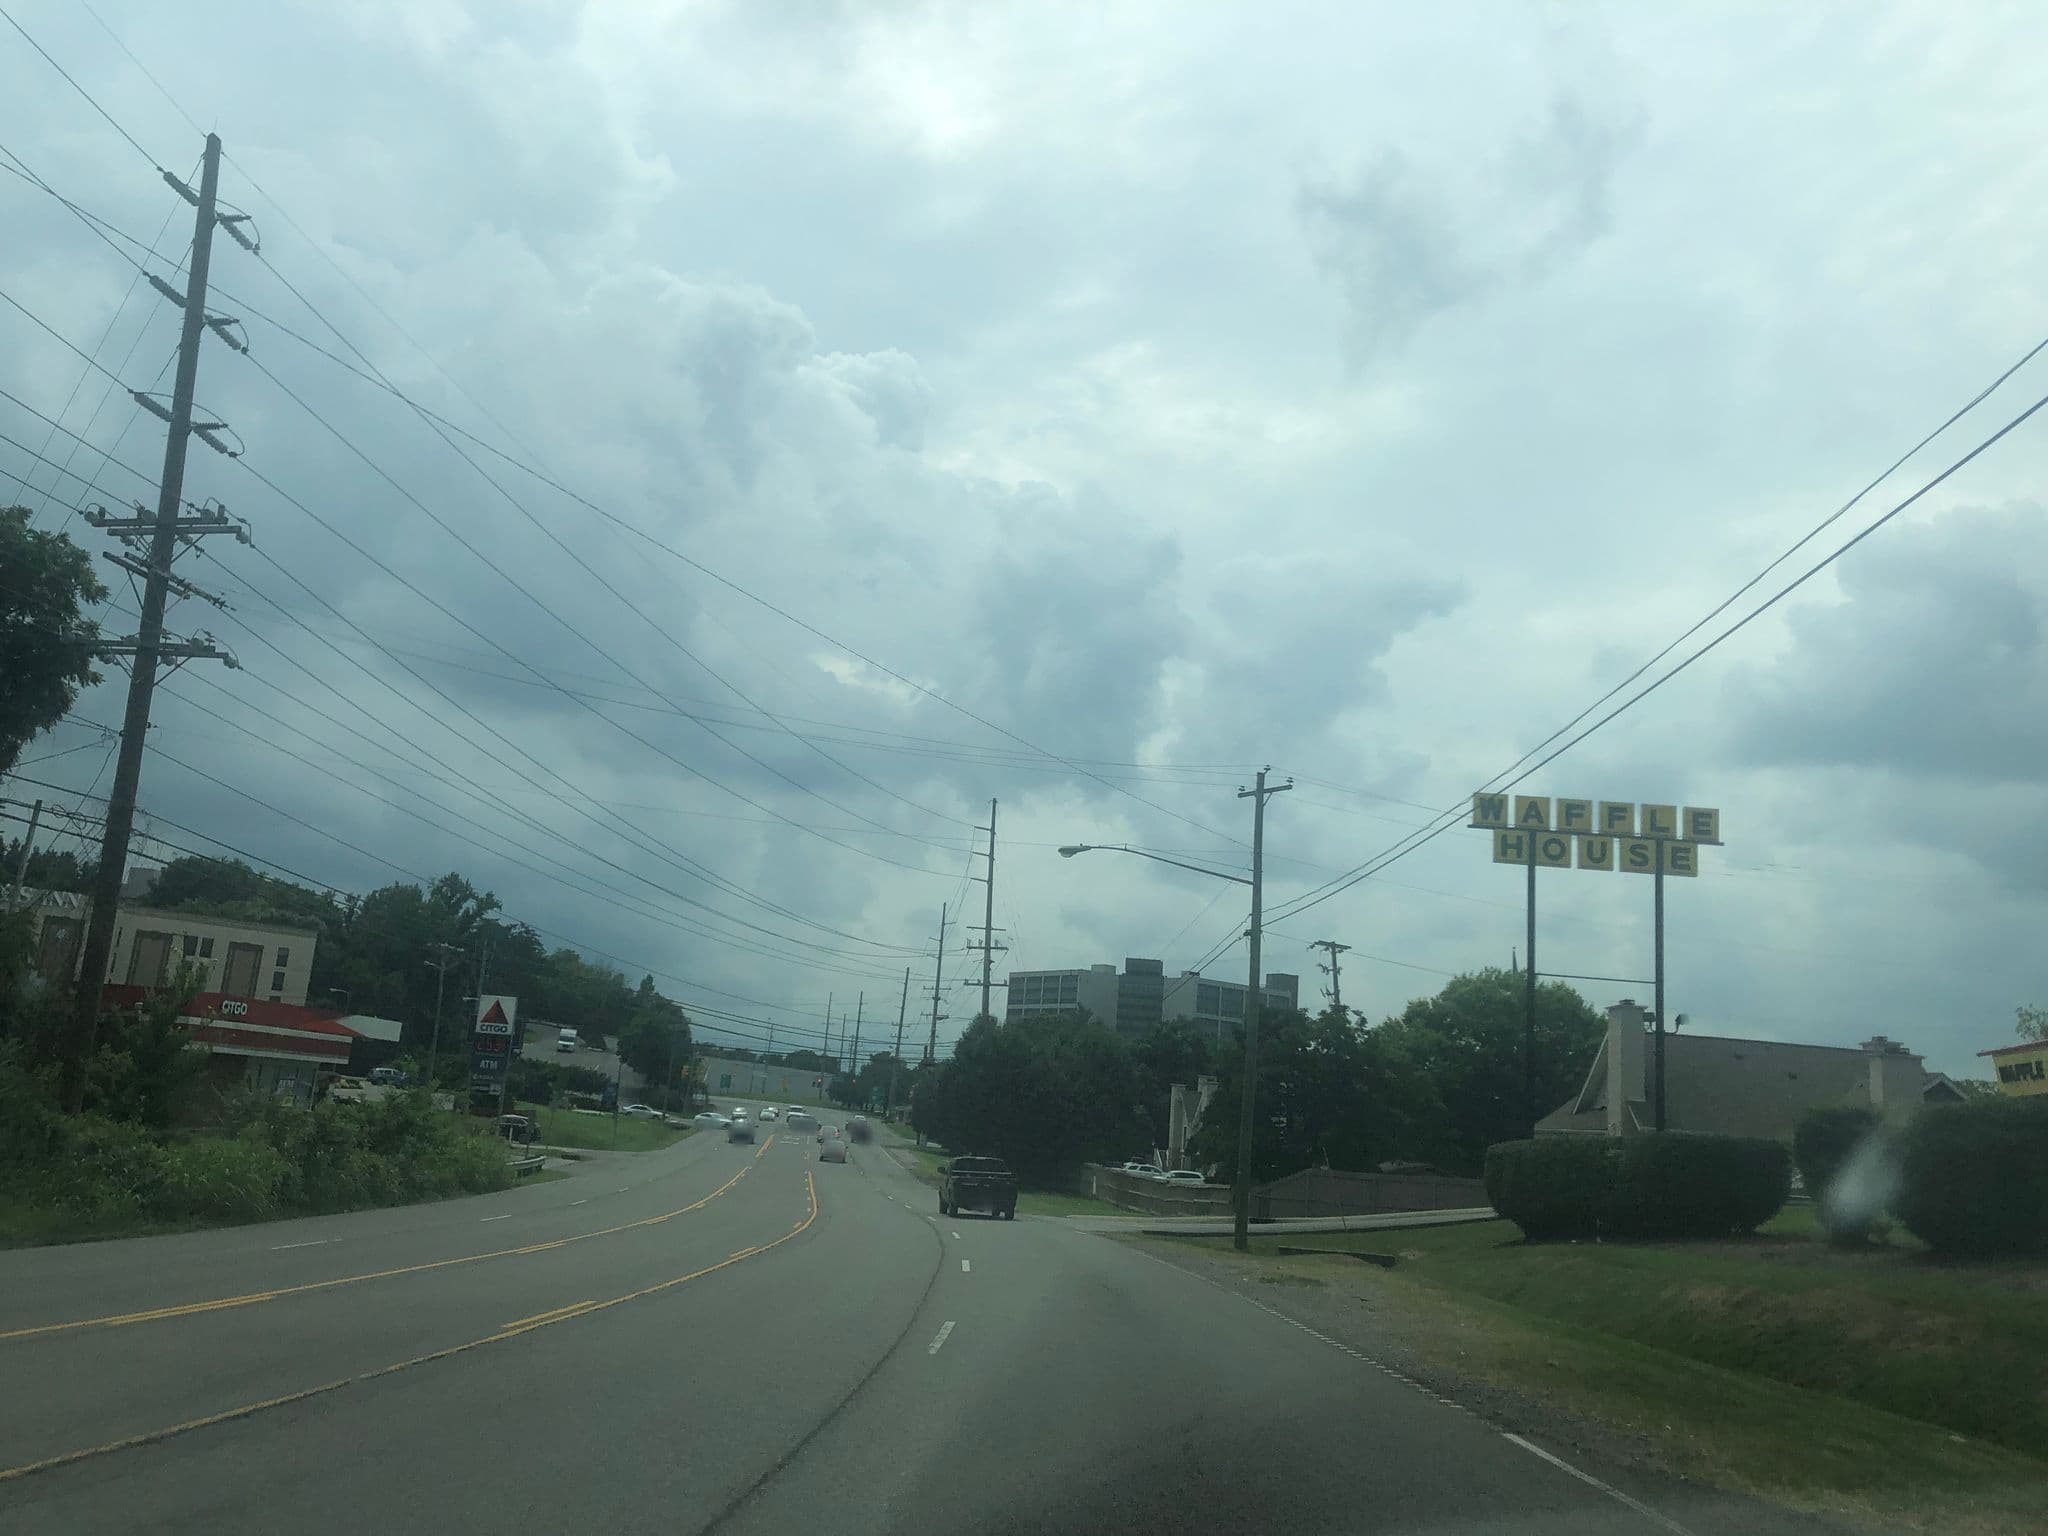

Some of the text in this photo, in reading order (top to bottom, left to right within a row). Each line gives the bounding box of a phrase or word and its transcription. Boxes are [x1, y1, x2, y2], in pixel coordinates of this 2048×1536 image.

[1479, 797, 1714, 836] WAFFLE
[1500, 833, 1691, 871] HOUSE
[222, 1000, 248, 1015] CITGO
[480, 1023, 507, 1033] CITGO
